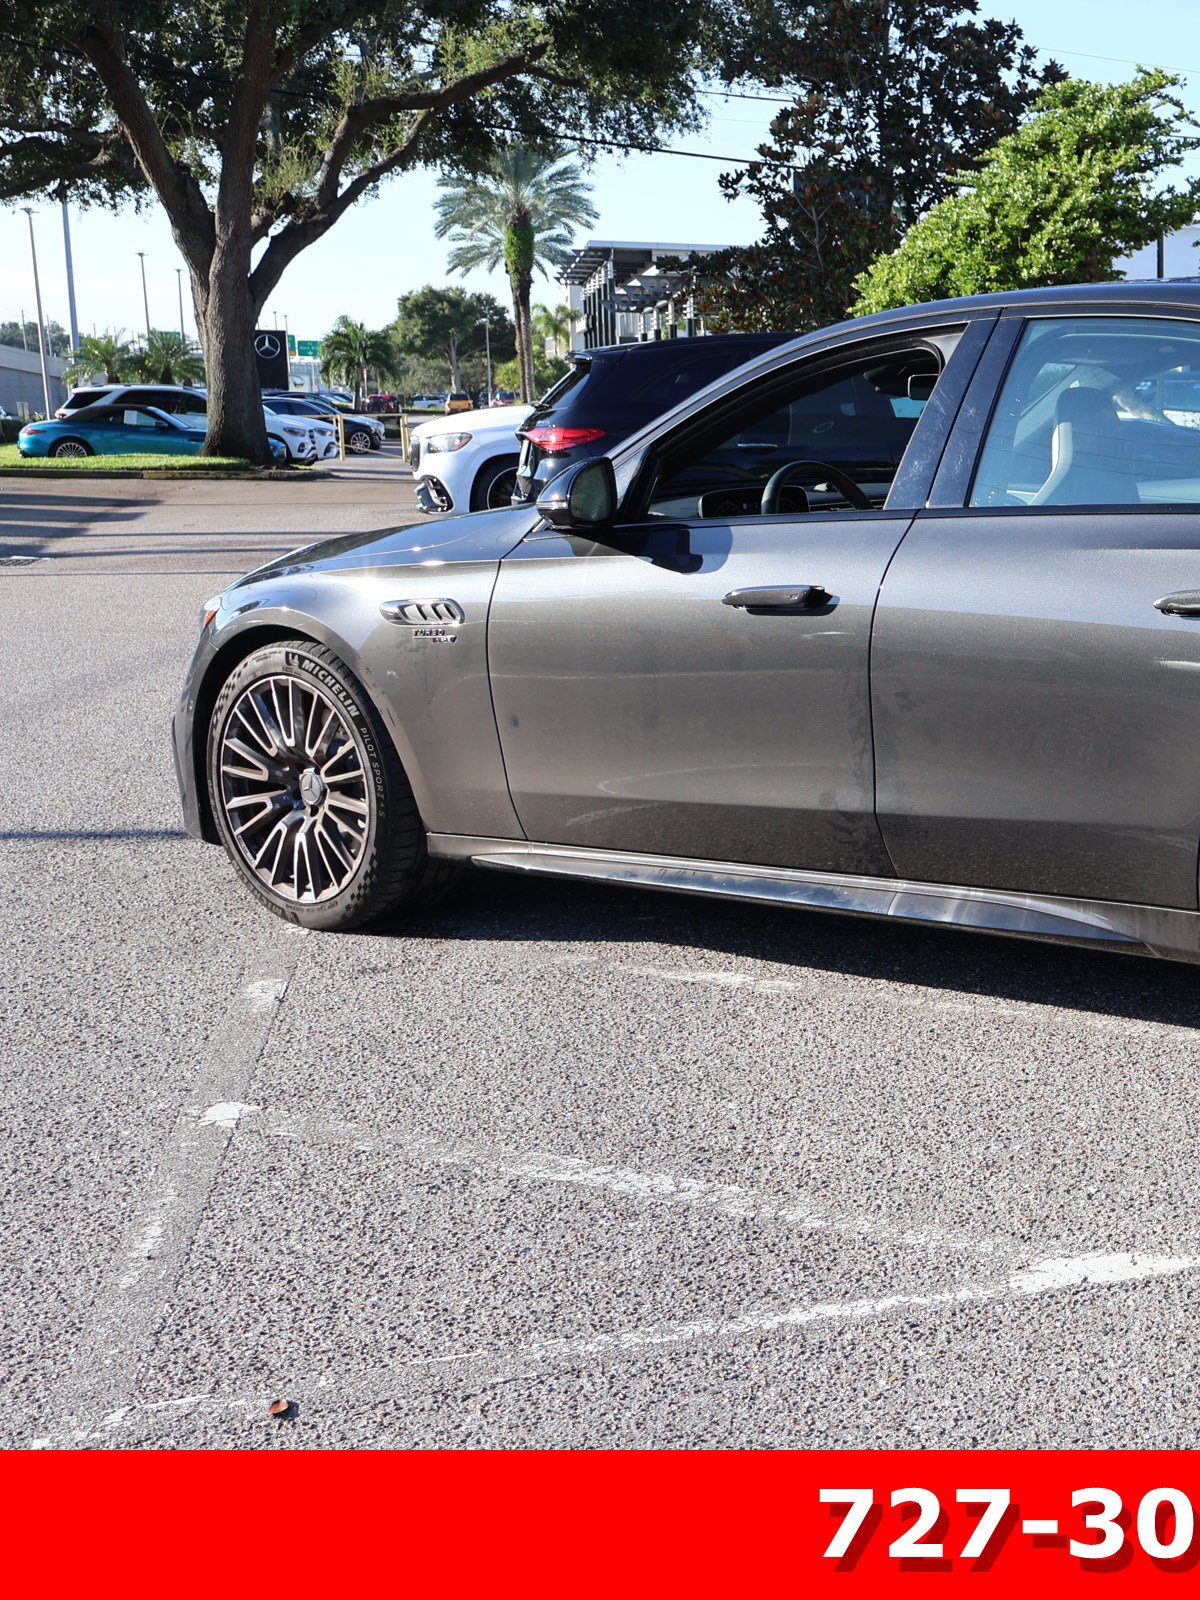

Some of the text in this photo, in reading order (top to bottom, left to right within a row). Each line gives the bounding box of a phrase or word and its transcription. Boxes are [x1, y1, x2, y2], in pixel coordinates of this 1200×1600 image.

[302, 659, 359, 717] MICHELIN
[360, 727, 377, 758] PILOT
[372, 762, 384, 800] SPORT
